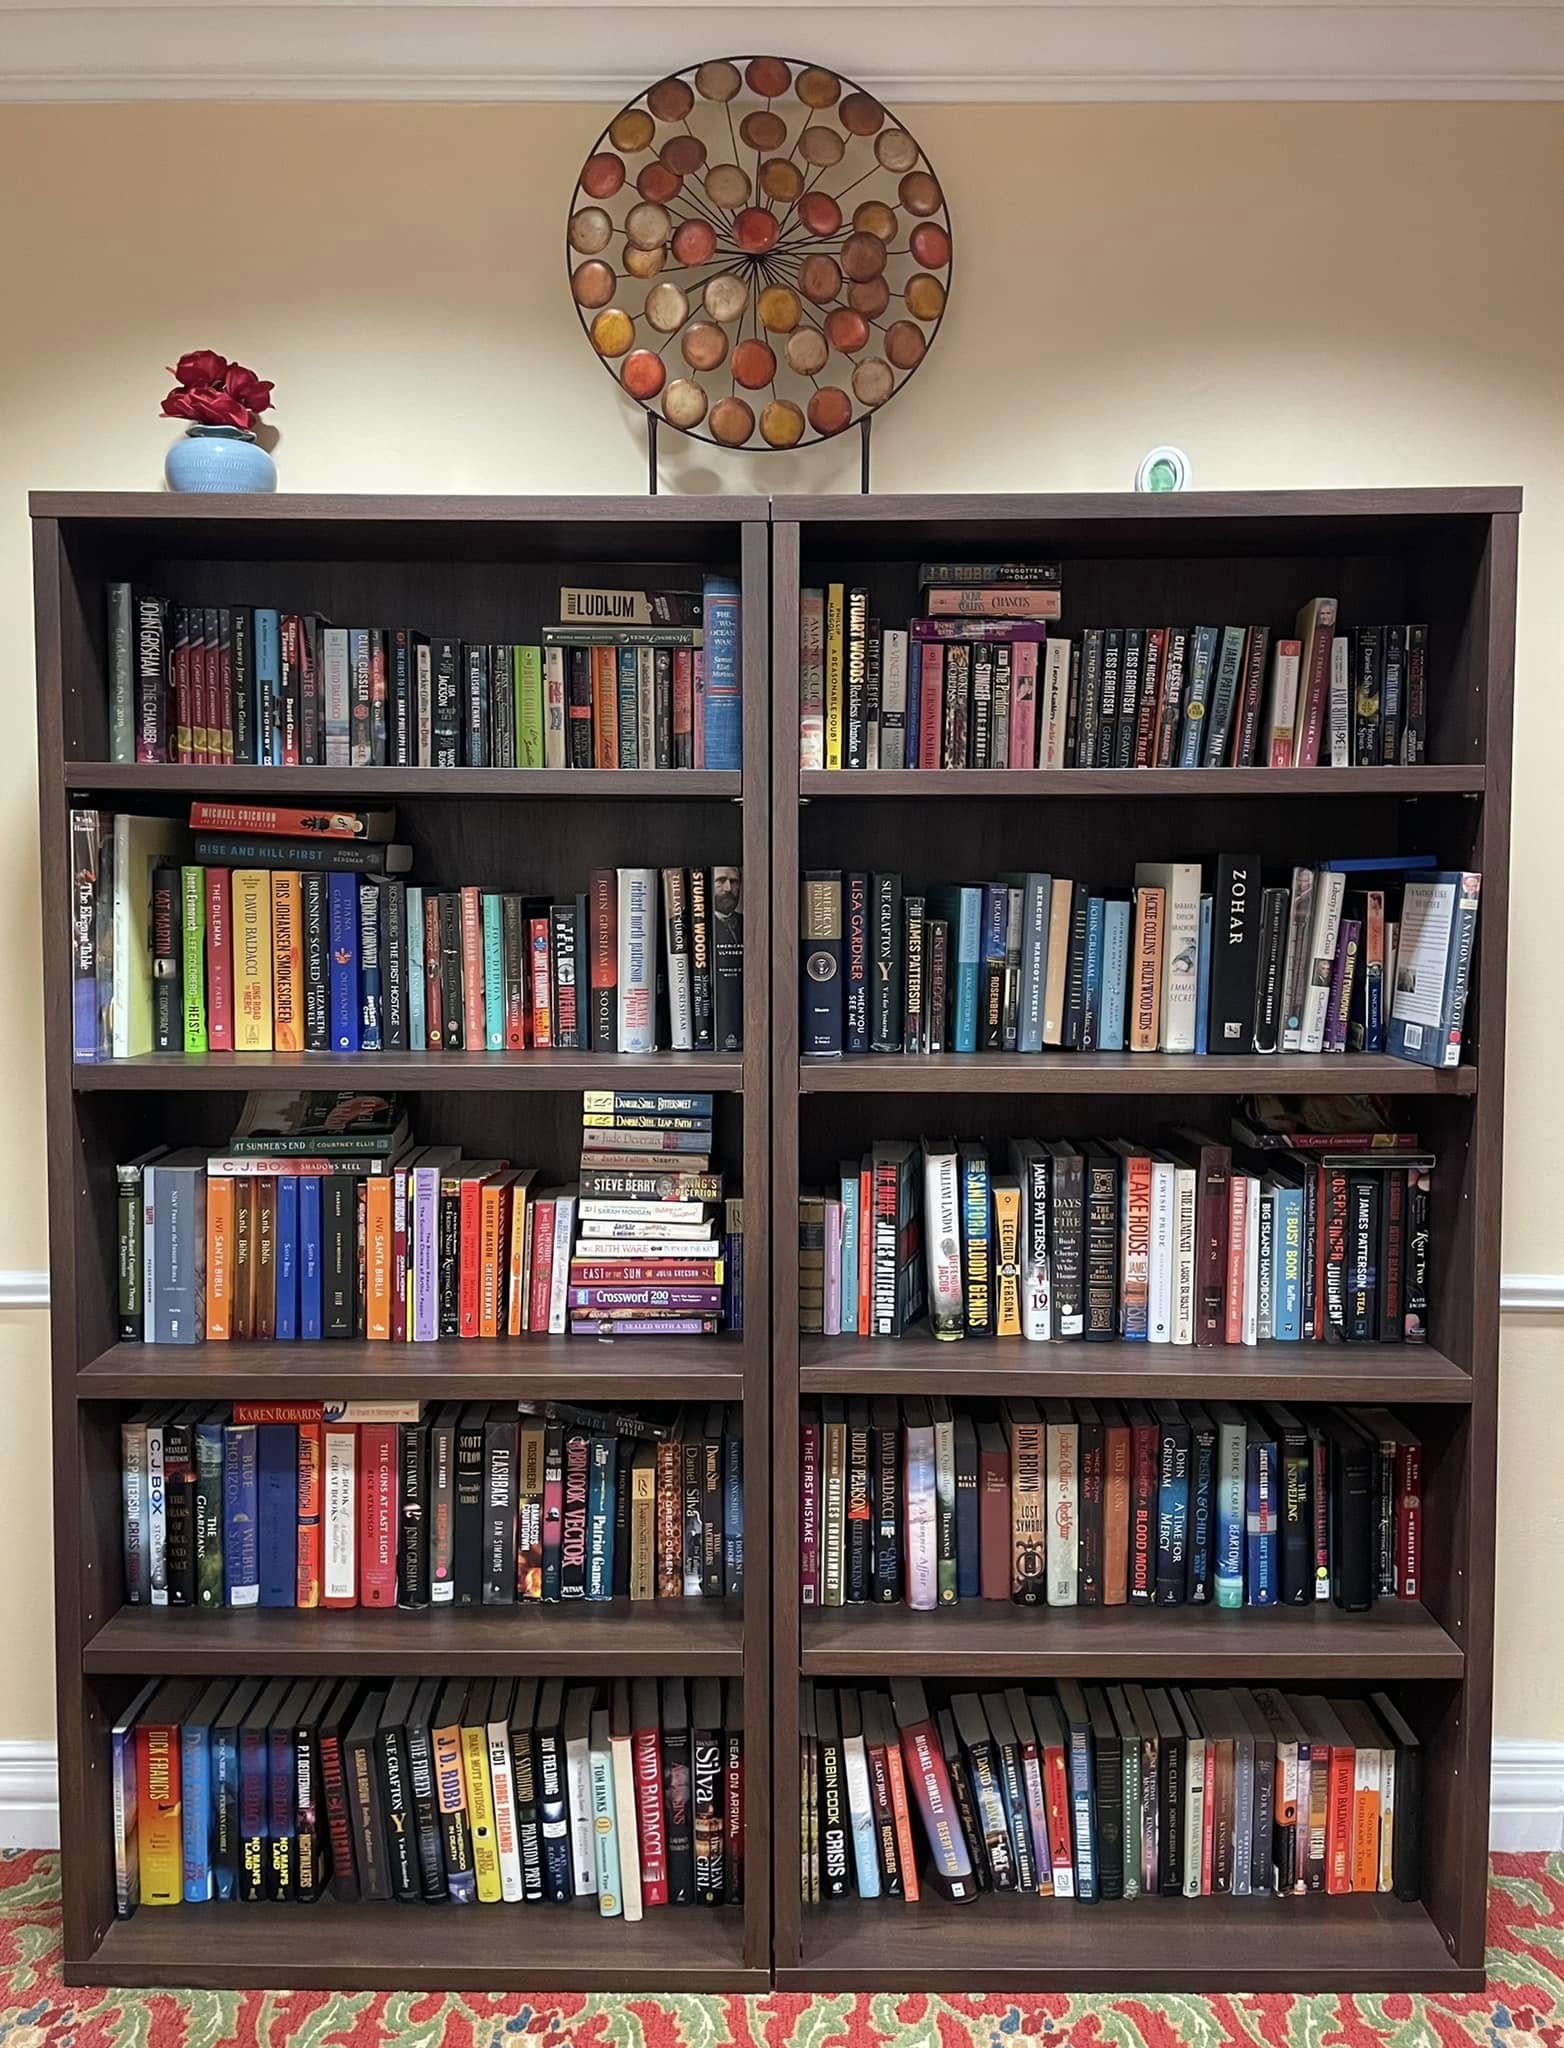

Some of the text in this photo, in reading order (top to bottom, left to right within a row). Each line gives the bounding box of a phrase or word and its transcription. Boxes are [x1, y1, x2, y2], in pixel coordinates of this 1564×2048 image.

[576, 593, 635, 618] LUDLUM
[140, 601, 160, 677] JOHN GRISHAM
[358, 634, 369, 701] CLIVE CUSSLER
[1145, 643, 1157, 695] JACK HIGGINS
[1169, 636, 1185, 703] CLIVE CUSSLER
[848, 594, 865, 752] STUART WOODS Reckless Abandon
[1103, 648, 1118, 714] TESS GERRITSEN
[1123, 648, 1139, 714] TESS GERRITSEN
[143, 683, 158, 745] THE CHAMBER
[200, 844, 324, 860] RISE AND KILL FIRST
[76, 884, 92, 970] The Elegant Table
[213, 884, 221, 947] THE DILEMMA
[246, 894, 257, 976] DAVID BALDACCI
[309, 881, 320, 981] RUNNING SCARED
[692, 872, 706, 968] STUART WOODS
[850, 880, 863, 980] LISA GARDNER
[881, 880, 892, 958] SUE GRAFTON
[1229, 870, 1246, 944] ZOHAR
[275, 880, 292, 1023] IRIS JOHANSEN SMOKESCREEN
[557, 924, 565, 957] BELL
[565, 927, 573, 951] TED
[598, 880, 610, 1041] JOHN GRISHAM SOOLEY
[908, 918, 921, 1013] JAMES PATTERSON
[252, 982, 261, 1020] LONG ROAD
[307, 992, 316, 1026] LOWELL
[317, 985, 325, 1033] ELIZABETH
[390, 940, 400, 1025] THE FIRST HOSTAGE
[848, 995, 856, 1026] SEE ME
[857, 987, 865, 1033] WHEN YOU
[989, 976, 999, 1025] ROSENBERG
[1139, 960, 1155, 1030] HOLLYWOOD KIDS
[189, 1006, 200, 1034] HEIST
[234, 1142, 244, 1150] AT
[246, 1142, 288, 1150] SUMMER'S
[290, 1142, 306, 1150] END
[594, 1178, 656, 1191] STEVE BERRY
[1033, 1164, 1046, 1267] JAMES PATTERSON
[1128, 1172, 1148, 1256] LAKE HOUSE
[375, 1235, 383, 1297] SANTA BIBLIA
[876, 1222, 895, 1317] JAMES PATTERSON
[967, 1174, 987, 1326] SANDFORD BLOODY GENIUS
[1003, 1219, 1014, 1323] LEE CHILD PERSONAL
[1260, 1203, 1270, 1316] BIG ISLAND HANDBOOK
[1286, 1218, 1298, 1280] BUSY BOOK
[1357, 1198, 1368, 1315] JAMES PATTERSON STEAL
[597, 1291, 668, 1302] Crossword 200
[1326, 1263, 1342, 1326] JUDGMENT
[239, 1408, 321, 1420] KAREN ROBARDS
[380, 1443, 388, 1462] THE
[490, 1450, 509, 1507] FLASHBACK
[1019, 1429, 1038, 1492] DAN BROWN
[1162, 1438, 1175, 1488] GRISHAM
[1176, 1448, 1185, 1478] JOHN
[380, 1495, 387, 1508] AT
[805, 1441, 813, 1543] THE FIRST MISTAKE
[197, 1495, 207, 1560] GUARDIANS
[207, 1517, 216, 1537] THE
[380, 1535, 388, 1565] LIGHT
[562, 1509, 585, 1567] VECTOR
[591, 1515, 605, 1595] Patriot Games
[1135, 1510, 1147, 1589] BLOOD MOON
[1160, 1513, 1172, 1552] MERCY
[1173, 1503, 1184, 1563] A TIME FOR
[1228, 1524, 1239, 1573] BEARTOWN
[149, 1731, 170, 1800] DICK FRANCIS
[492, 1750, 506, 1766] CUT
[541, 1738, 558, 1795] JOY FIELDING
[594, 1765, 606, 1812] TOM HANKS
[696, 1746, 721, 1803] Silva
[730, 1738, 738, 1837] DEAD ON ARRIVAL
[441, 1772, 461, 1809] ROBB
[640, 1735, 661, 1856] DAVID BALDACCI
[824, 1747, 845, 1876] ROBIN COOK CRISIS
[914, 1735, 958, 1872] MICHAEL CONNELLY DESERT STAR
[252, 1837, 260, 1885] NO MAN'S
[280, 1837, 288, 1885] NO MAN'S
[882, 1826, 896, 1873] ROSENBERG
